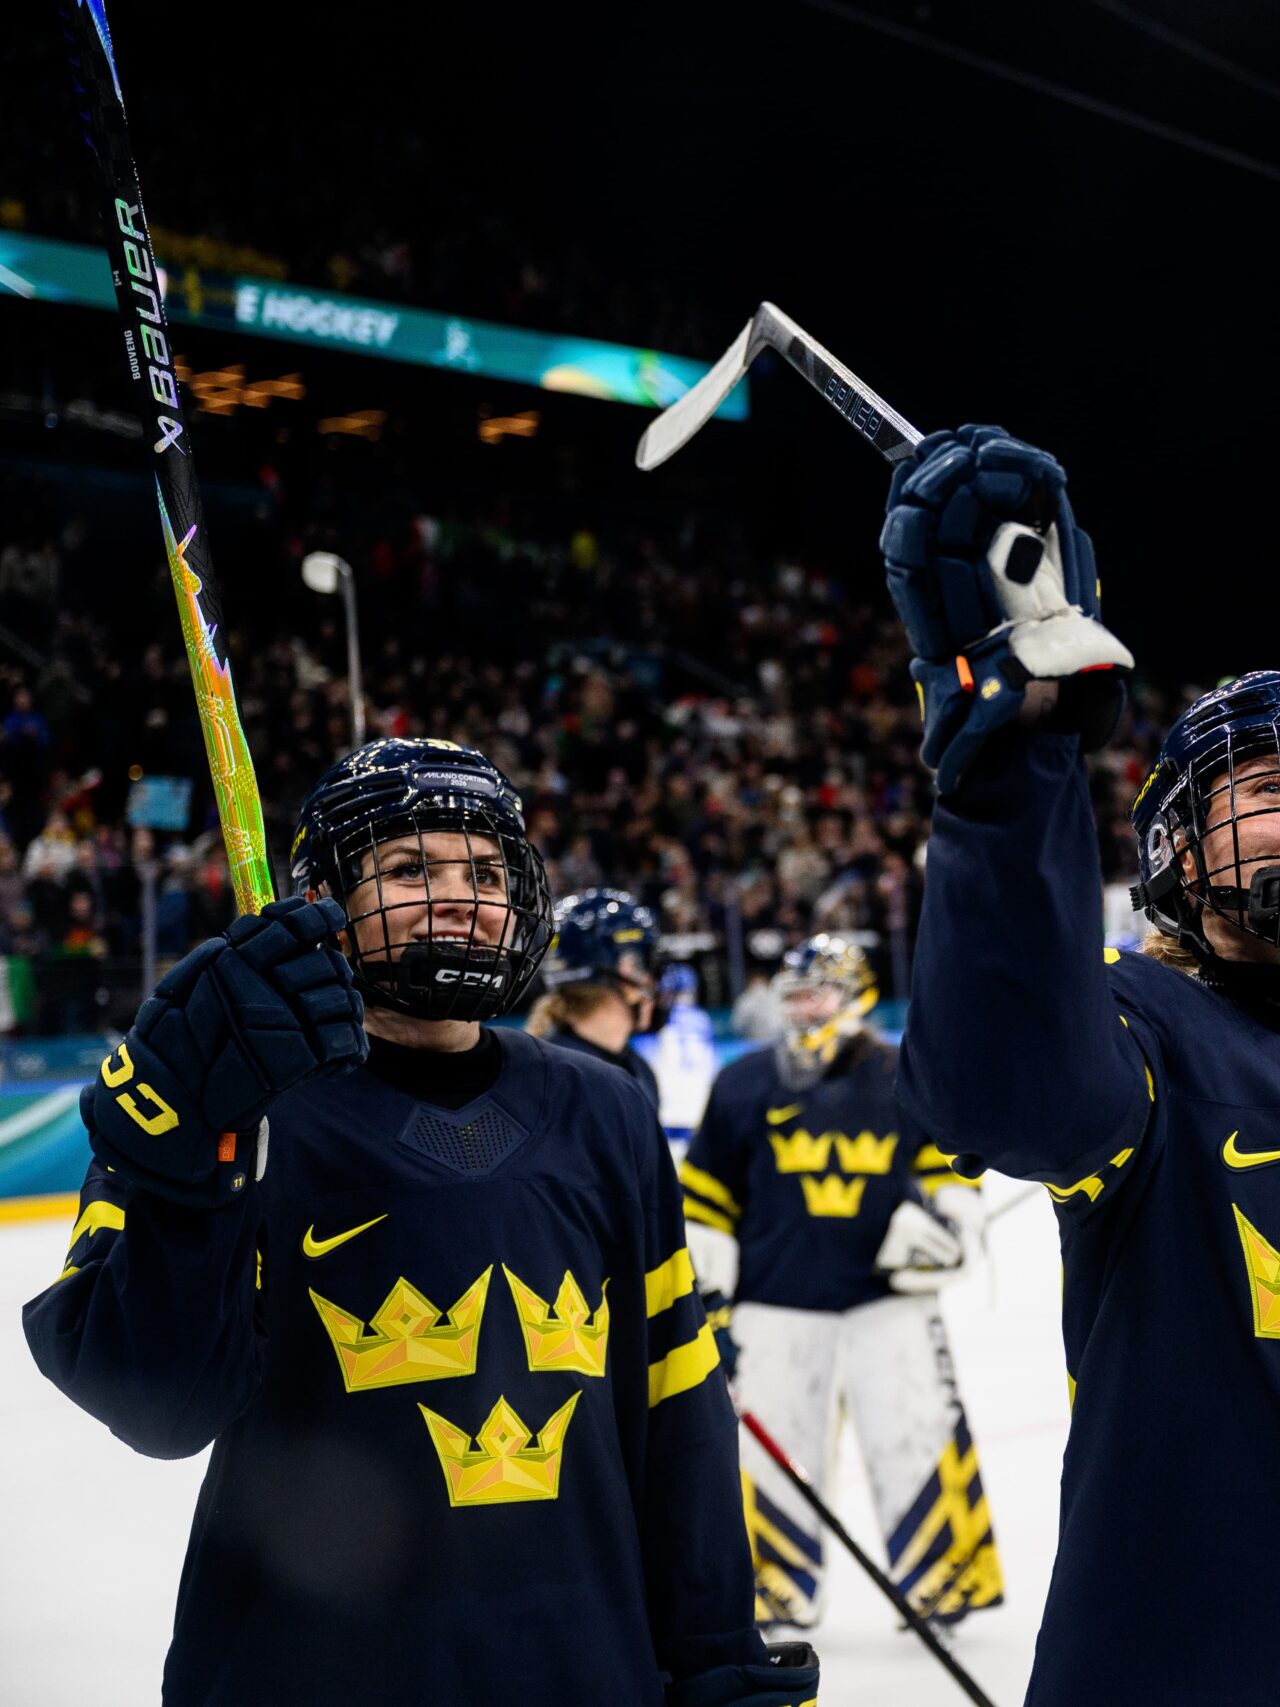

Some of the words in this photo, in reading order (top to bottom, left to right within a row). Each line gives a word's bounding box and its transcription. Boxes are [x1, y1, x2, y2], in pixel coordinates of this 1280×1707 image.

[261, 290, 399, 348] HOCKEY
[124, 329, 142, 381] BOUVENG
[423, 772, 457, 780] MILANO
[458, 773, 490, 785] CORTINA
[434, 968, 504, 989] CCM
[234, 1176, 243, 1188] 11
